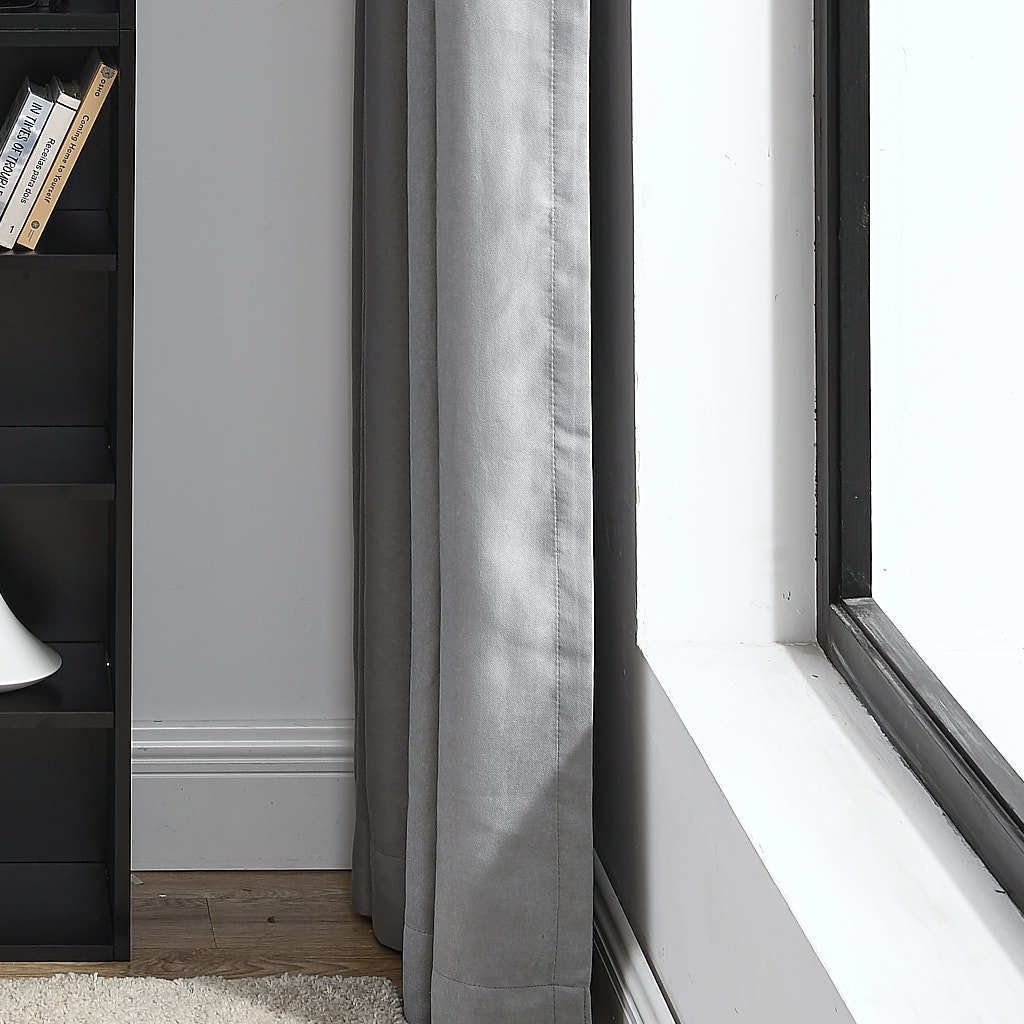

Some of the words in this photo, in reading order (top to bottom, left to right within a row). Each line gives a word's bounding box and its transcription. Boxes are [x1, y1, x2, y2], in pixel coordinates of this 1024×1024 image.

[95, 79, 106, 97] OSHO
[30, 101, 44, 115] IN
[17, 115, 37, 142] TIMES
[71, 115, 90, 142] Coming
[11, 142, 24, 157] OF
[63, 143, 78, 164] Home
[57, 164, 66, 173] to
[27, 169, 40, 187] para
[20, 186, 32, 204] dois
[44, 175, 62, 203] Yourself
